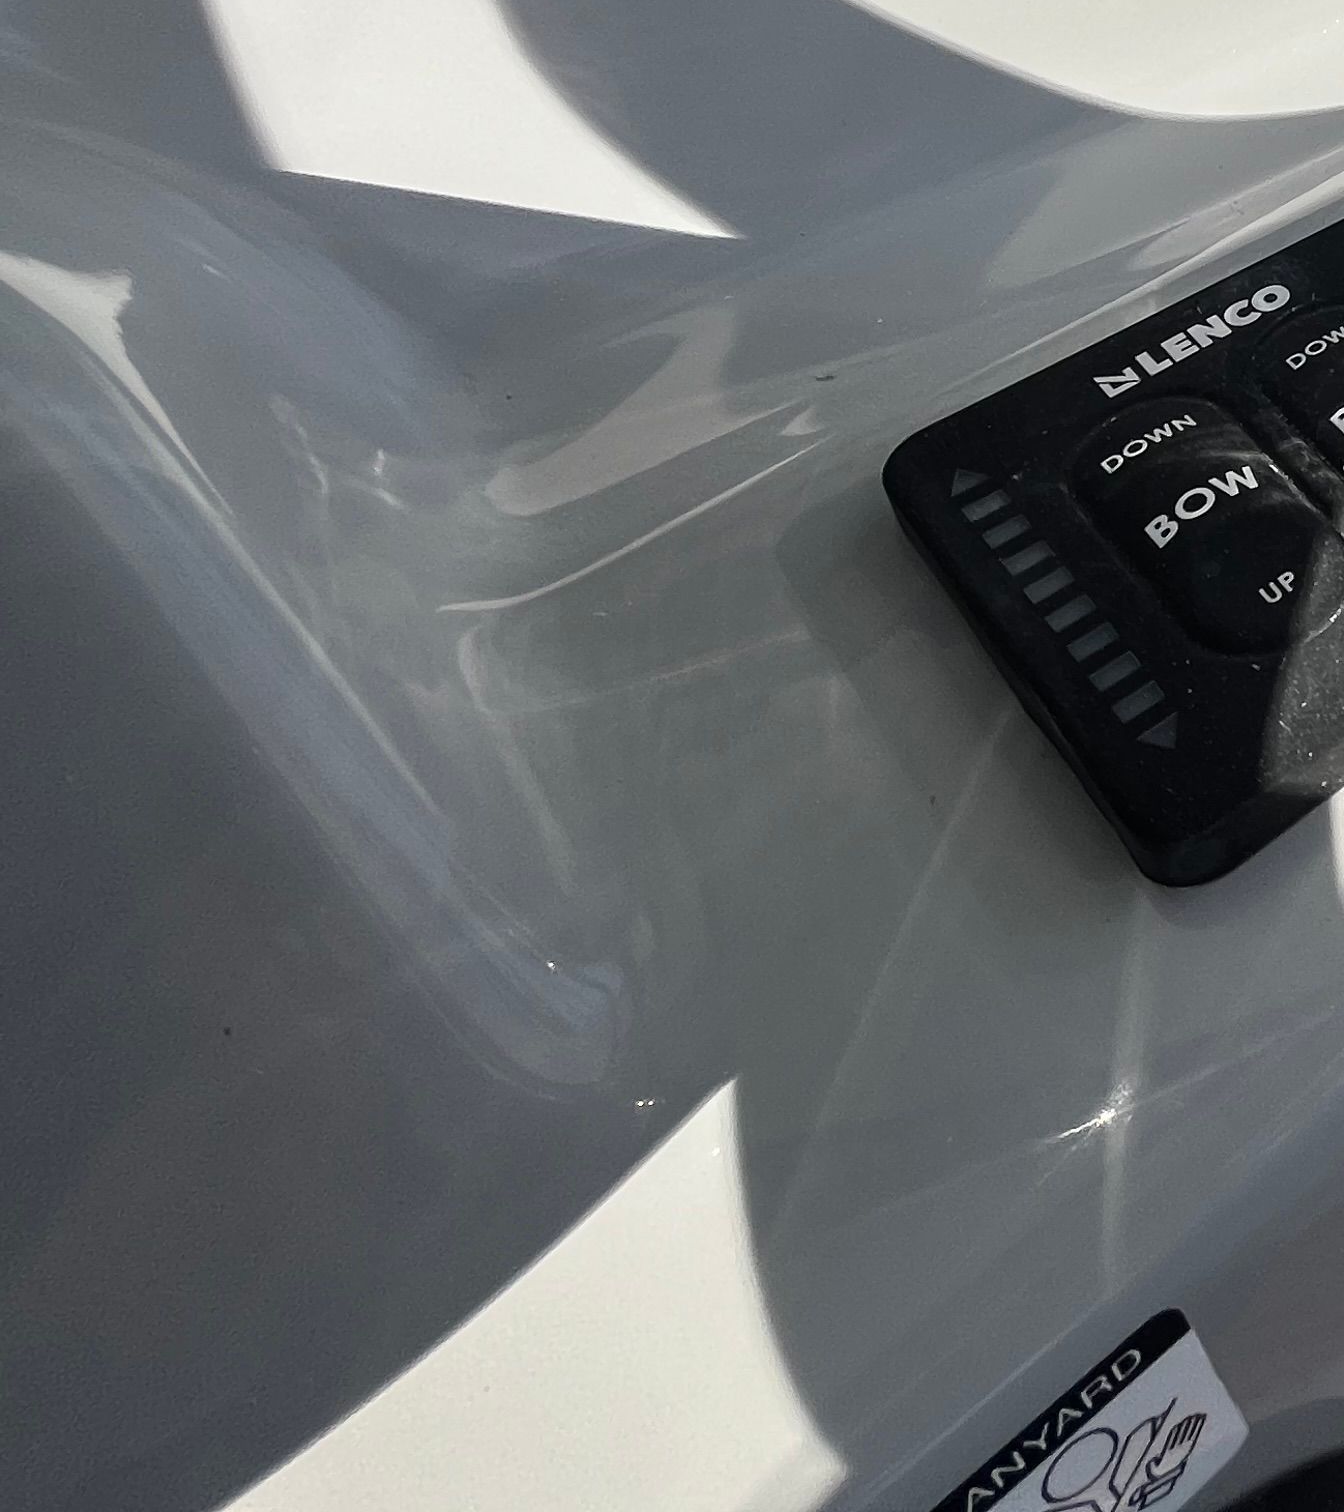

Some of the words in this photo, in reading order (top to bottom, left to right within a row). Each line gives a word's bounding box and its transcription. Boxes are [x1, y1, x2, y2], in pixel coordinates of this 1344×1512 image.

[1135, 284, 1291, 377] LENCO
[1100, 414, 1198, 475] DOWN
[1144, 465, 1259, 549] BOW
[1258, 571, 1296, 604] UP
